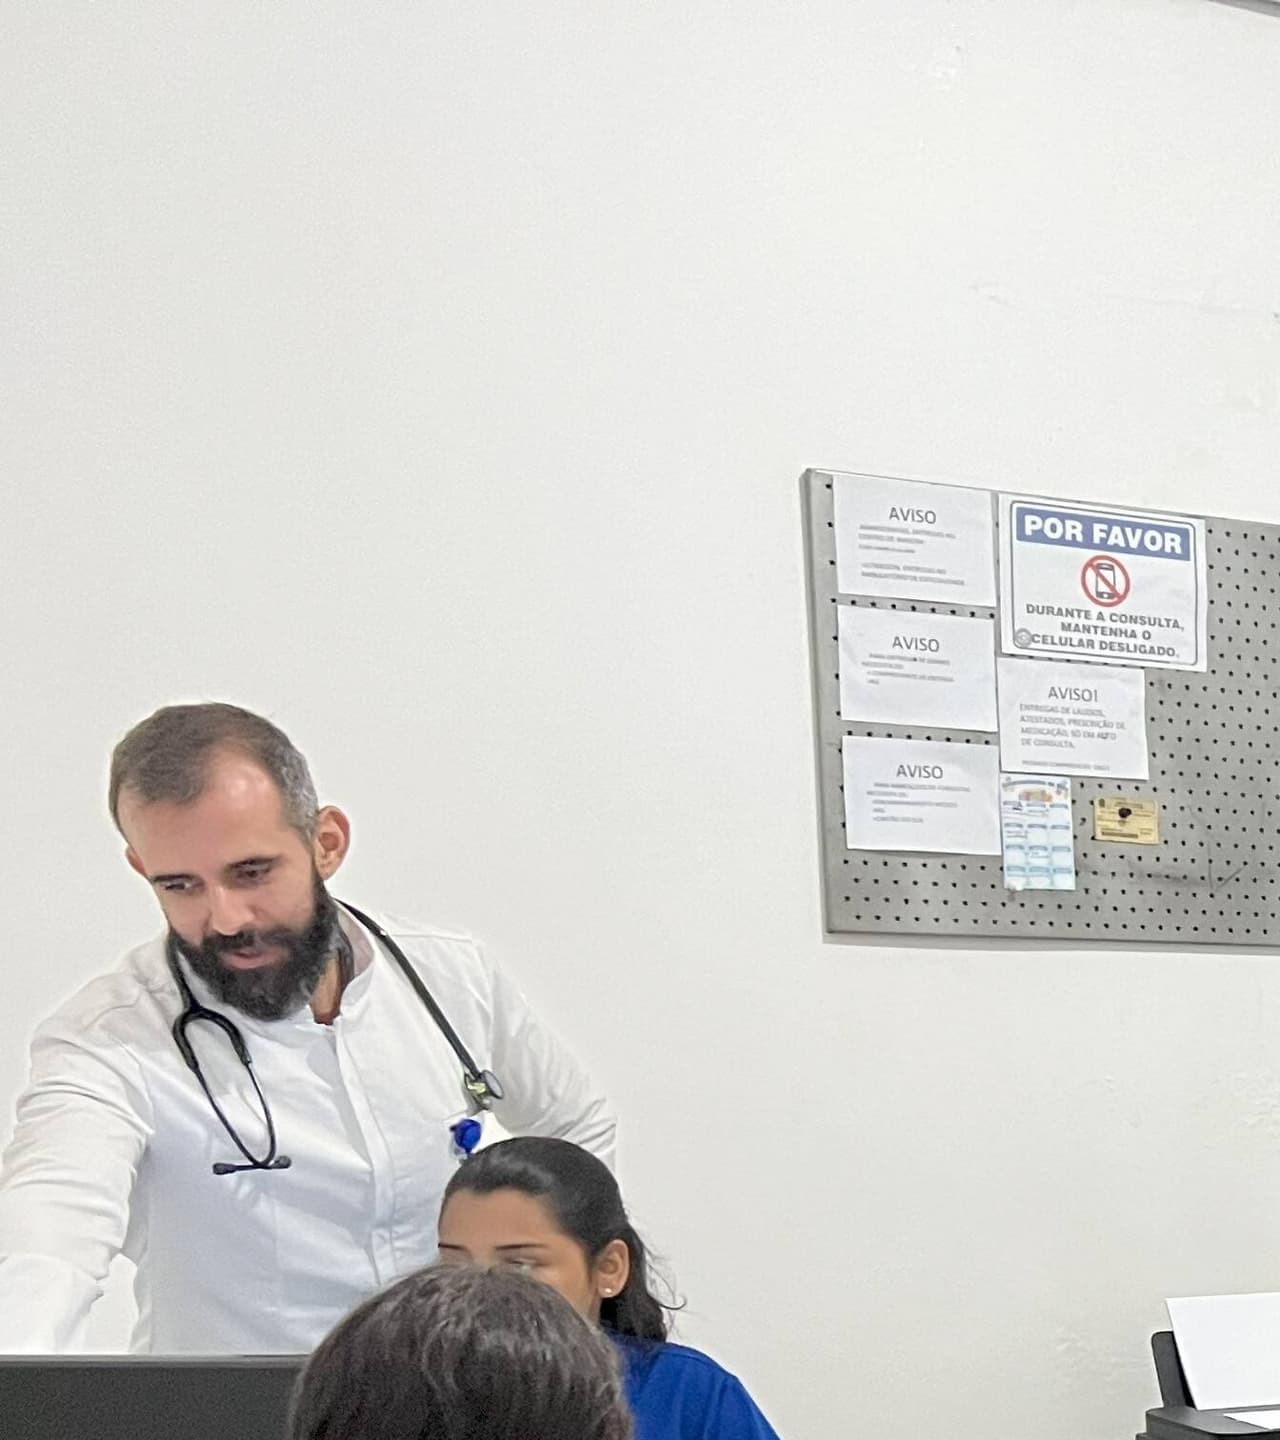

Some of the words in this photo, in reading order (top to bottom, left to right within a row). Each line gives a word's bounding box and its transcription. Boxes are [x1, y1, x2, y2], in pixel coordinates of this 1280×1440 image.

[889, 507, 937, 524] AVISO
[1024, 515, 1083, 543] POR
[1092, 523, 1182, 554] FAVOR
[1026, 604, 1092, 620] DURANTE
[1096, 611, 1105, 621] A
[1109, 612, 1184, 631] CONSULTA,
[1061, 622, 1137, 639] MANTENHA
[1142, 630, 1151, 641] O
[892, 636, 940, 652] AVISO
[1031, 634, 1095, 649] CELULAR
[1099, 641, 1179, 658] DESLIGADO.
[896, 764, 943, 779] AVISO
